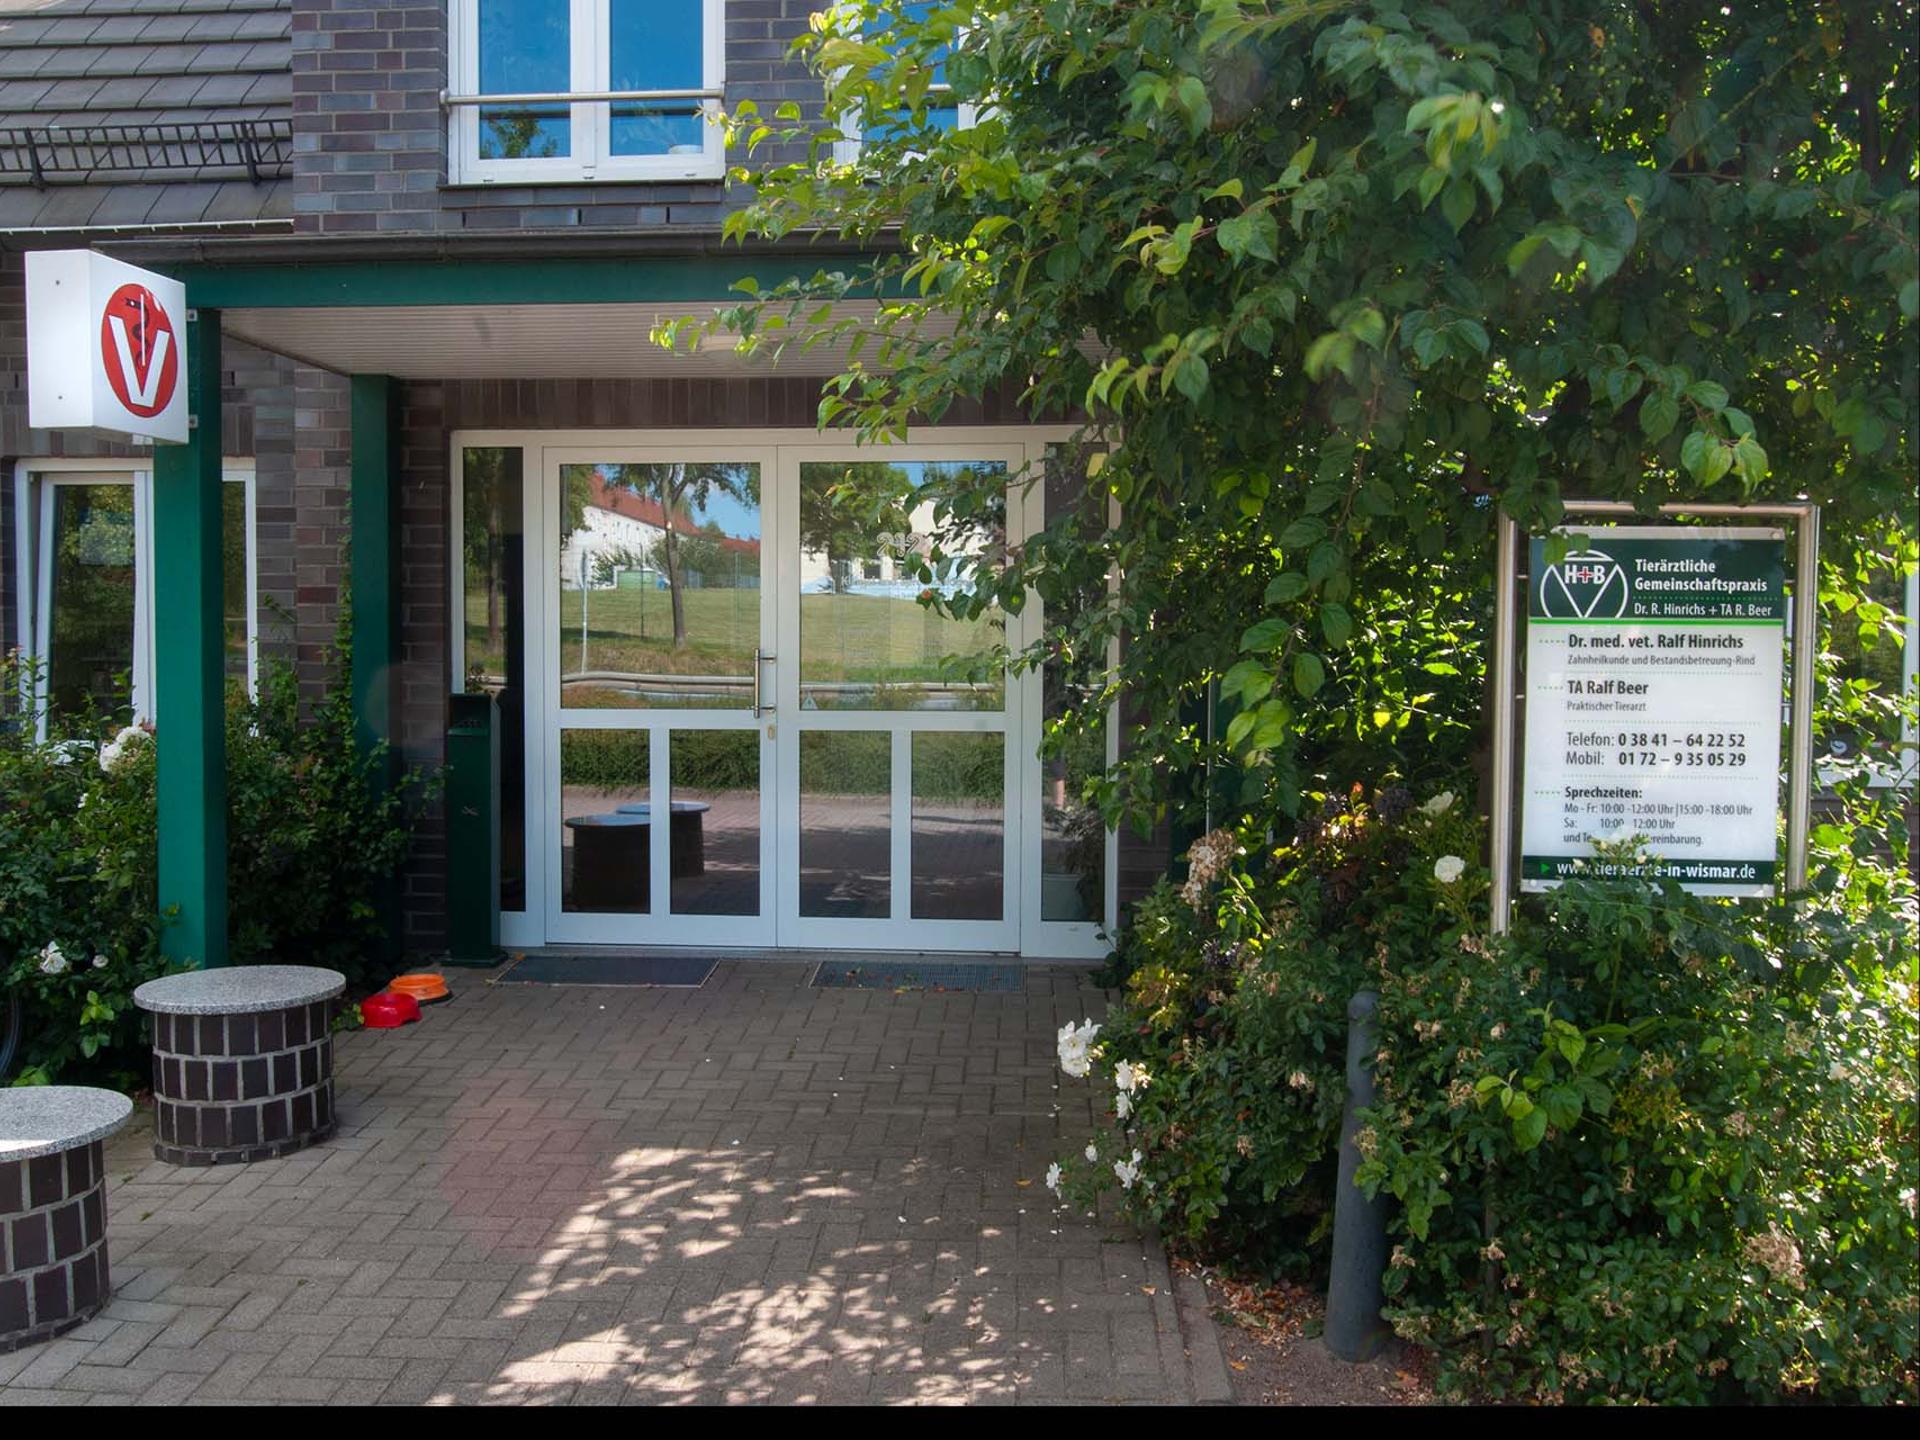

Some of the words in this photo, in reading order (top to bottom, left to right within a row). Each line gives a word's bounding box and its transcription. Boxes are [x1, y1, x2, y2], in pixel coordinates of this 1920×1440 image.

[108, 314, 171, 408] V
[1635, 558, 1716, 574] Tierärztliche
[1634, 576, 1768, 594] Gemeinschaftspraxis
[1634, 602, 1649, 615] Dr.
[1651, 603, 1662, 616] R.
[1664, 602, 1706, 616] Hinrichs
[1721, 603, 1734, 616] TA
[1735, 604, 1747, 616] R.
[1748, 604, 1773, 617] Beer
[1568, 634, 1588, 649] Dr.
[1591, 634, 1625, 649] med.
[1628, 635, 1655, 649] vet.
[1657, 633, 1687, 649] Ralf
[1688, 634, 1744, 649] Hinrichs
[1567, 655, 1630, 666] Zahnheilkunde
[1631, 655, 1649, 666] und
[1568, 680, 1583, 694] TA
[1586, 680, 1615, 694] Ralf
[1617, 680, 1649, 695] Beer
[1567, 701, 1614, 712] Praktischer
[1614, 701, 1647, 712] Tierarzt
[1566, 732, 1615, 747] Telefon:
[1630, 733, 1648, 747] 38
[1651, 733, 1668, 747] 41
[1686, 733, 1704, 748] 64
[1707, 733, 1725, 748] 22
[1727, 734, 1746, 748] 52
[1566, 751, 1605, 766] Mobil:
[1618, 752, 1635, 766] 01
[1640, 752, 1657, 766] 72
[1686, 752, 1704, 766] 35
[1707, 753, 1725, 767] 05
[1728, 753, 1747, 767] 29
[1565, 785, 1643, 800] Sprechzeiten:
[1564, 803, 1579, 813] Mo
[1600, 803, 1625, 814] 10:00
[1657, 804, 1674, 814] Uhr
[1736, 804, 1753, 815] Uhr
[1633, 819, 1658, 829] 12:00
[1659, 819, 1675, 829] Uhr
[1563, 833, 1581, 843] und
